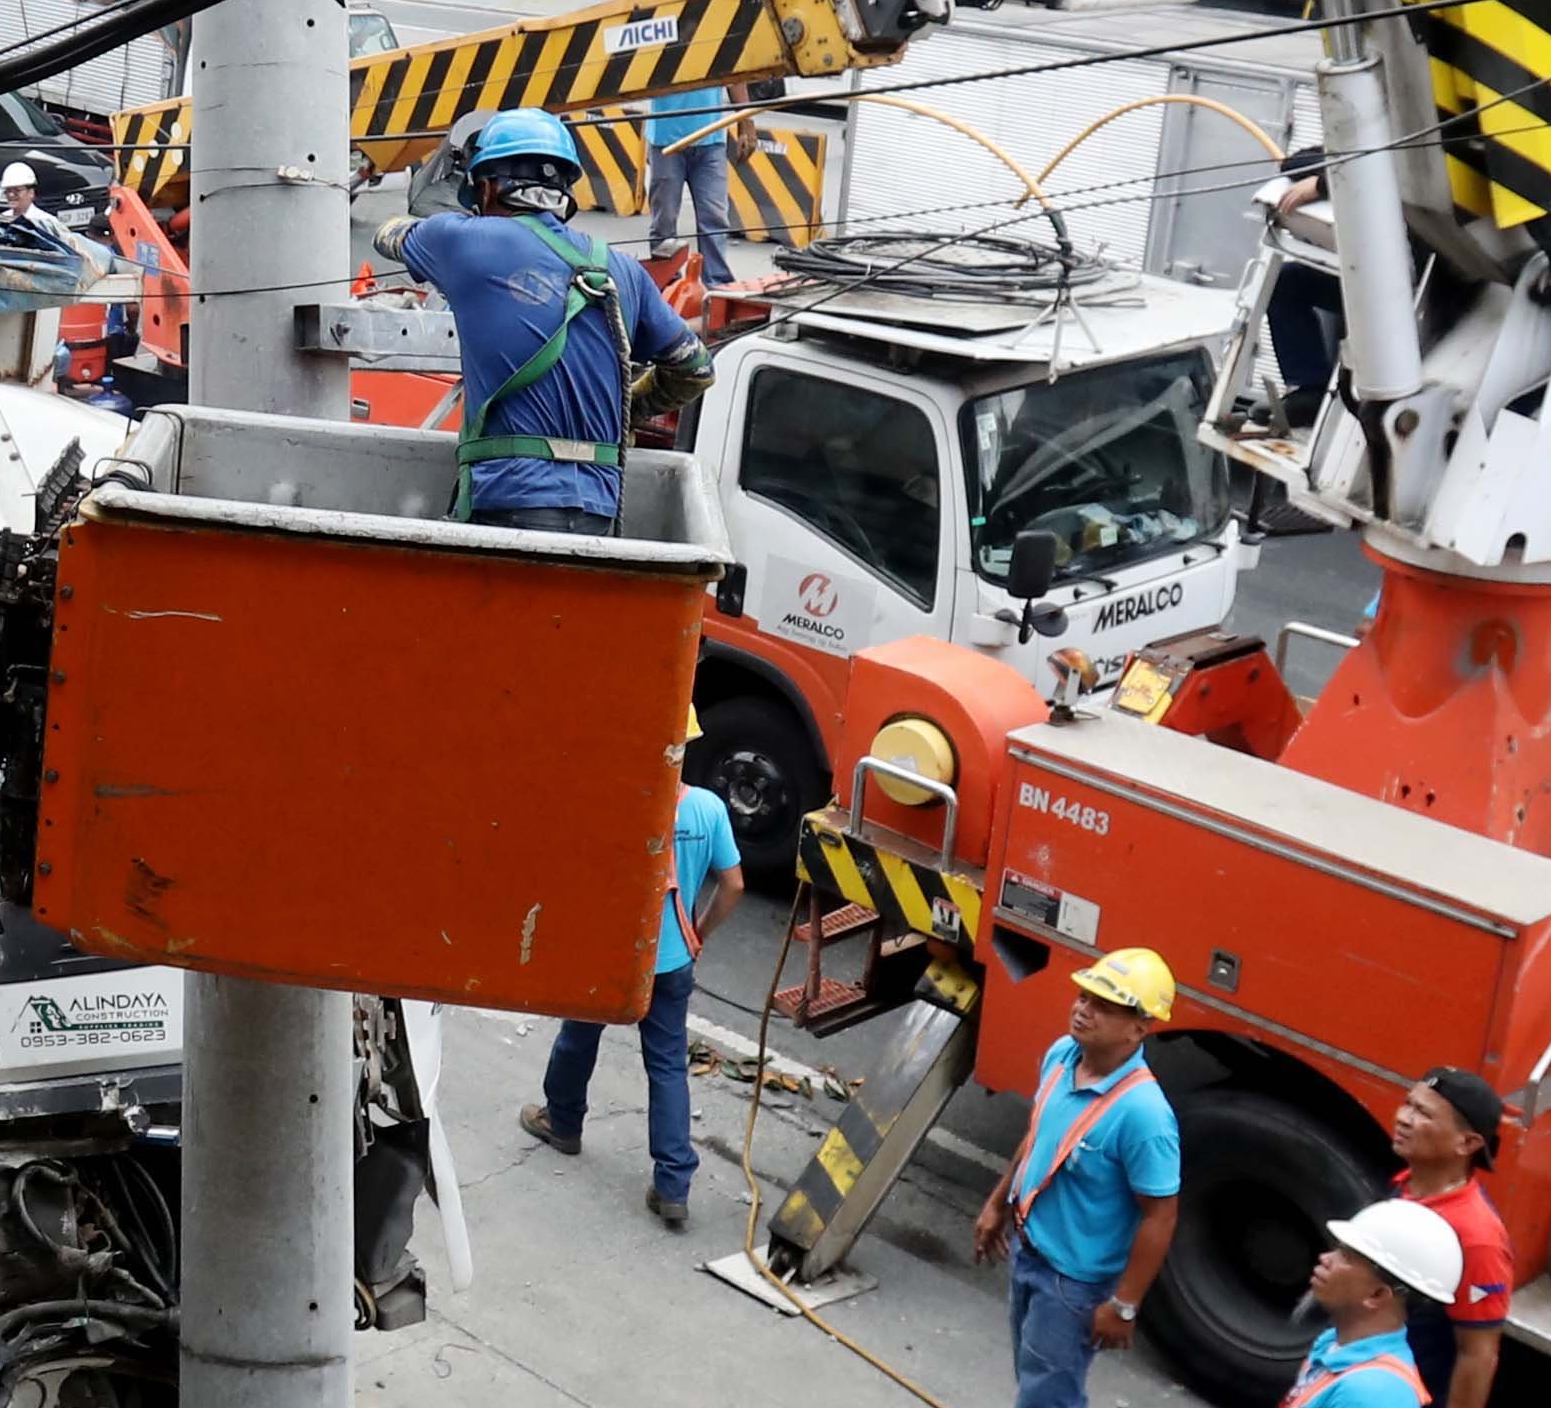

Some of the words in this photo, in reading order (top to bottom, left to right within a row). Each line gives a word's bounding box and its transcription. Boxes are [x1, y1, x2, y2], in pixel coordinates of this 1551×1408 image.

[618, 20, 674, 48] AICHI
[1093, 582, 1184, 634] MERALCO
[782, 612, 845, 641] MERALCO
[1019, 782, 1051, 814] BN
[1051, 797, 1111, 835] 4483
[69, 992, 167, 1011] ALINDAYA
[75, 1009, 169, 1021] CONSTRUCTION
[20, 1029, 166, 1049] 0953-382-0623
